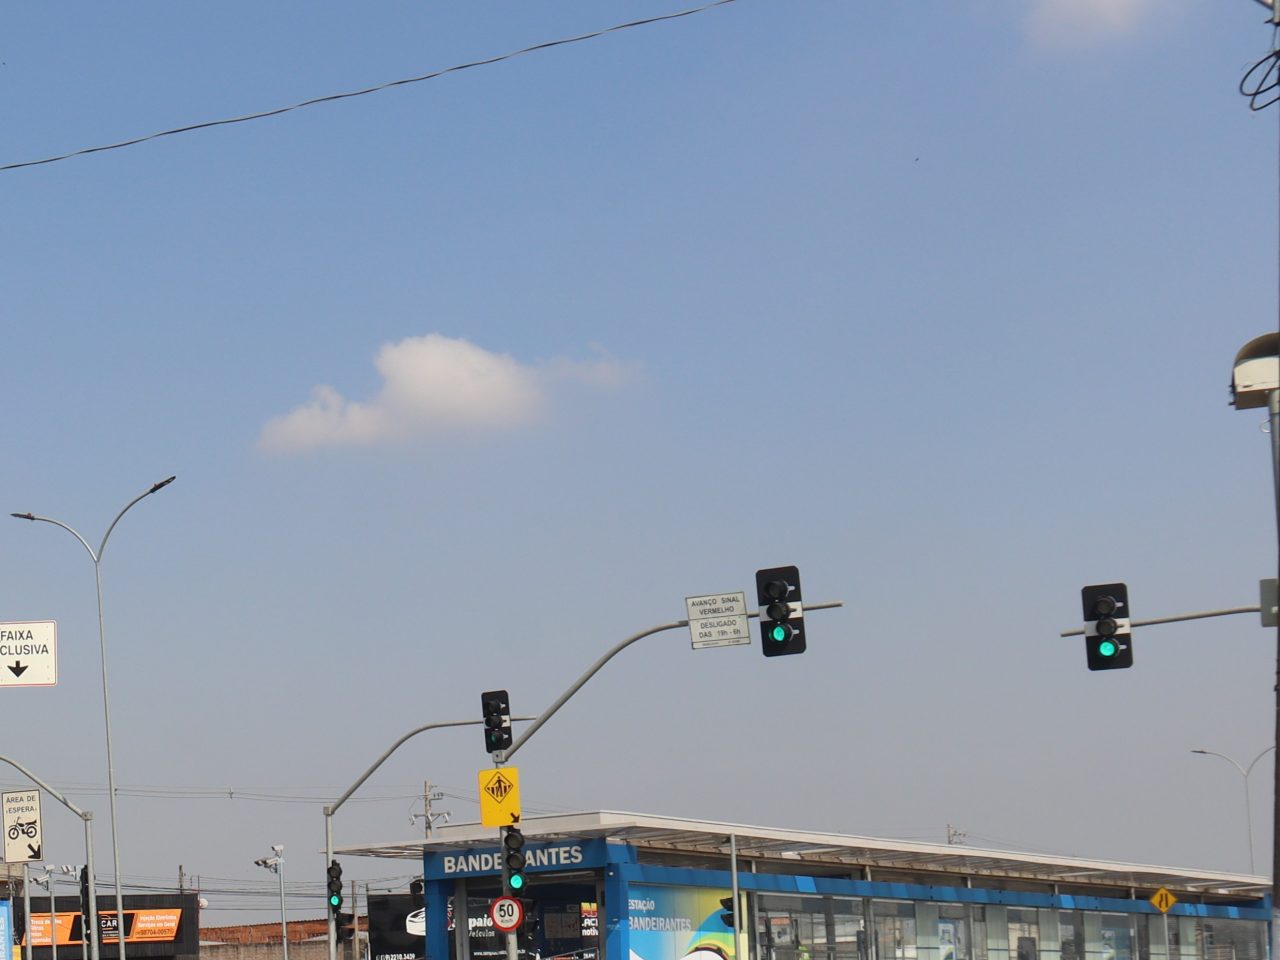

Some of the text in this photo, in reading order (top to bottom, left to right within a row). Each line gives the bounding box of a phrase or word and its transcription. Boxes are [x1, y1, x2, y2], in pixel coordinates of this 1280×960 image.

[691, 596, 740, 607] AVANÇO SINAL
[699, 606, 734, 615] VERMELHO
[700, 620, 736, 629] DESLIGADO
[0, 630, 34, 641] FAIXA
[8, 806, 34, 814] ESPERA
[444, 846, 584, 874] BANDEANTES
[499, 904, 514, 918] 50
[628, 898, 656, 913] ESTAÇÃO
[101, 920, 118, 928] CAR
[628, 916, 692, 931] BANDEIRANTES
